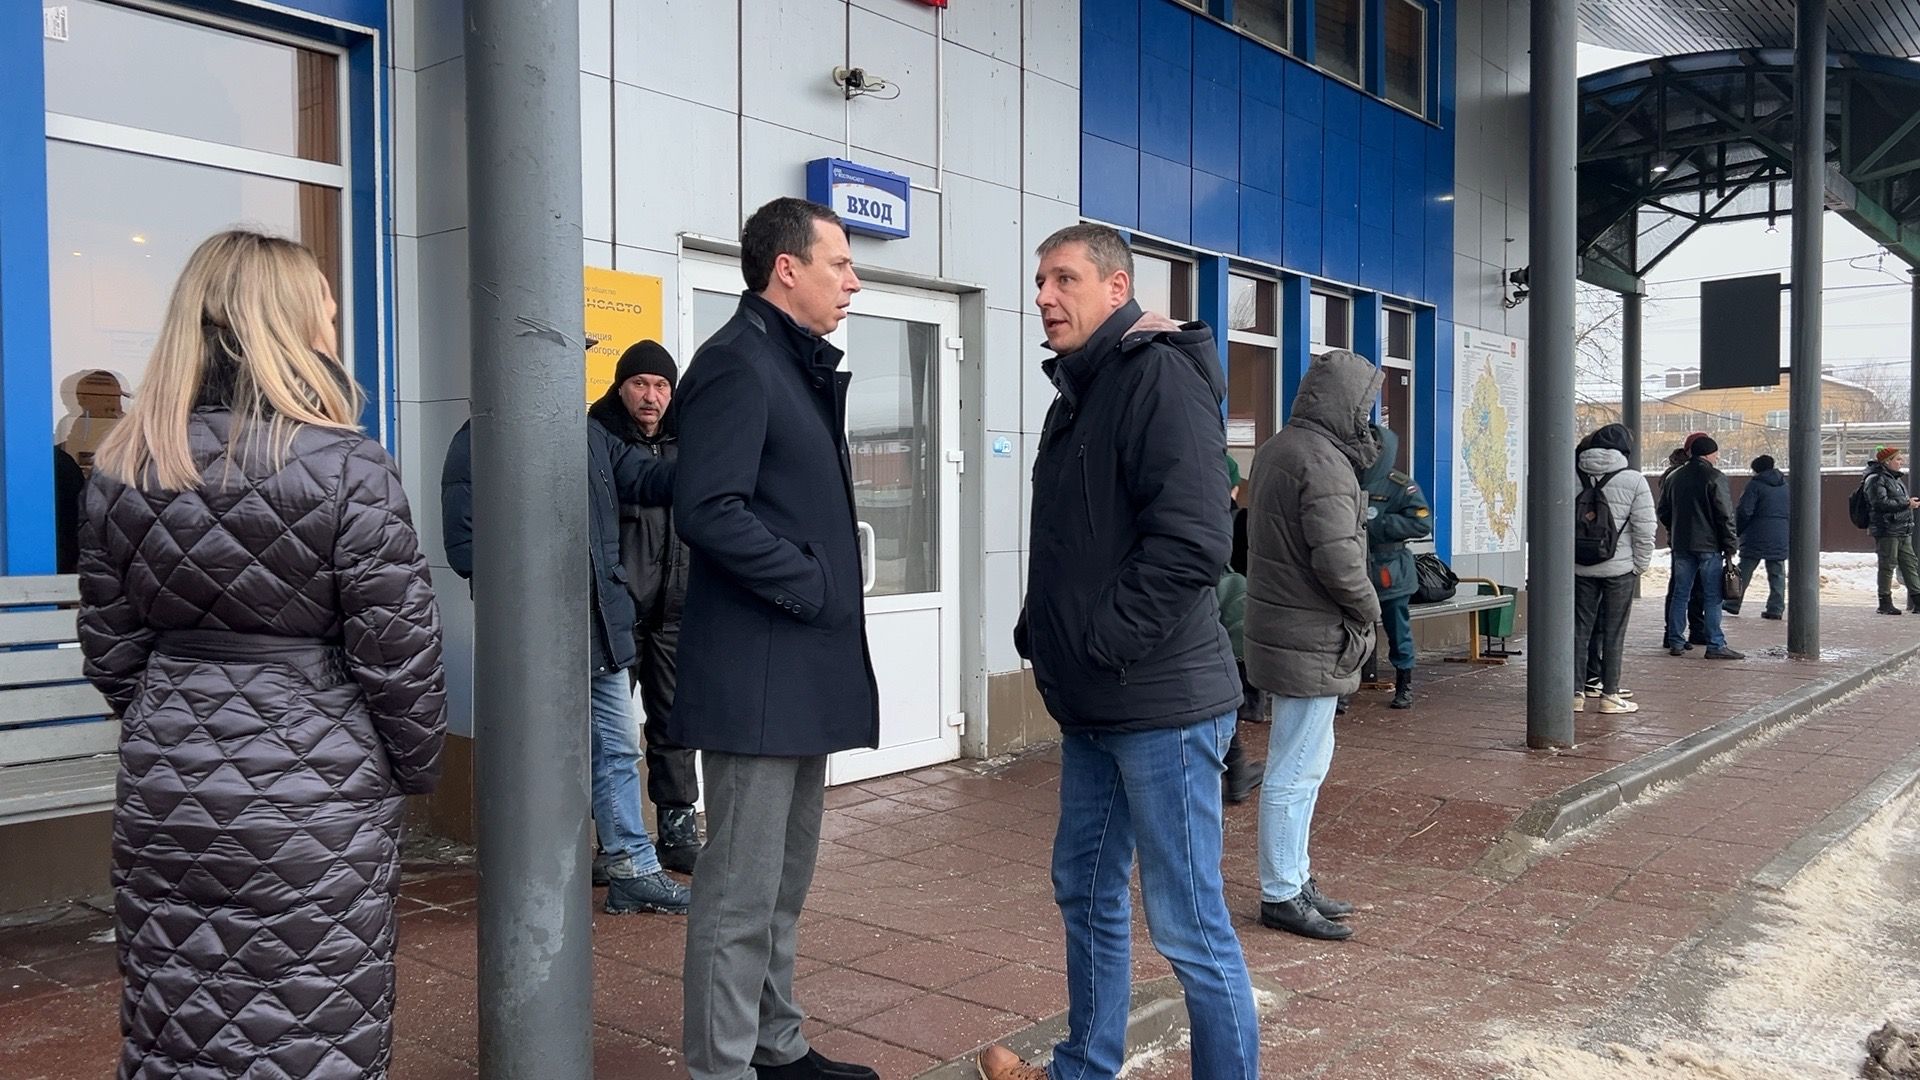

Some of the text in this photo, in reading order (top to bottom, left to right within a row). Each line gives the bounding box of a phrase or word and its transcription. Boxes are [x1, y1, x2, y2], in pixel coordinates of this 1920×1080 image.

[847, 195, 893, 225] ВХОД
[585, 298, 642, 315] НСАВТО
[587, 346, 620, 357] ногорск
